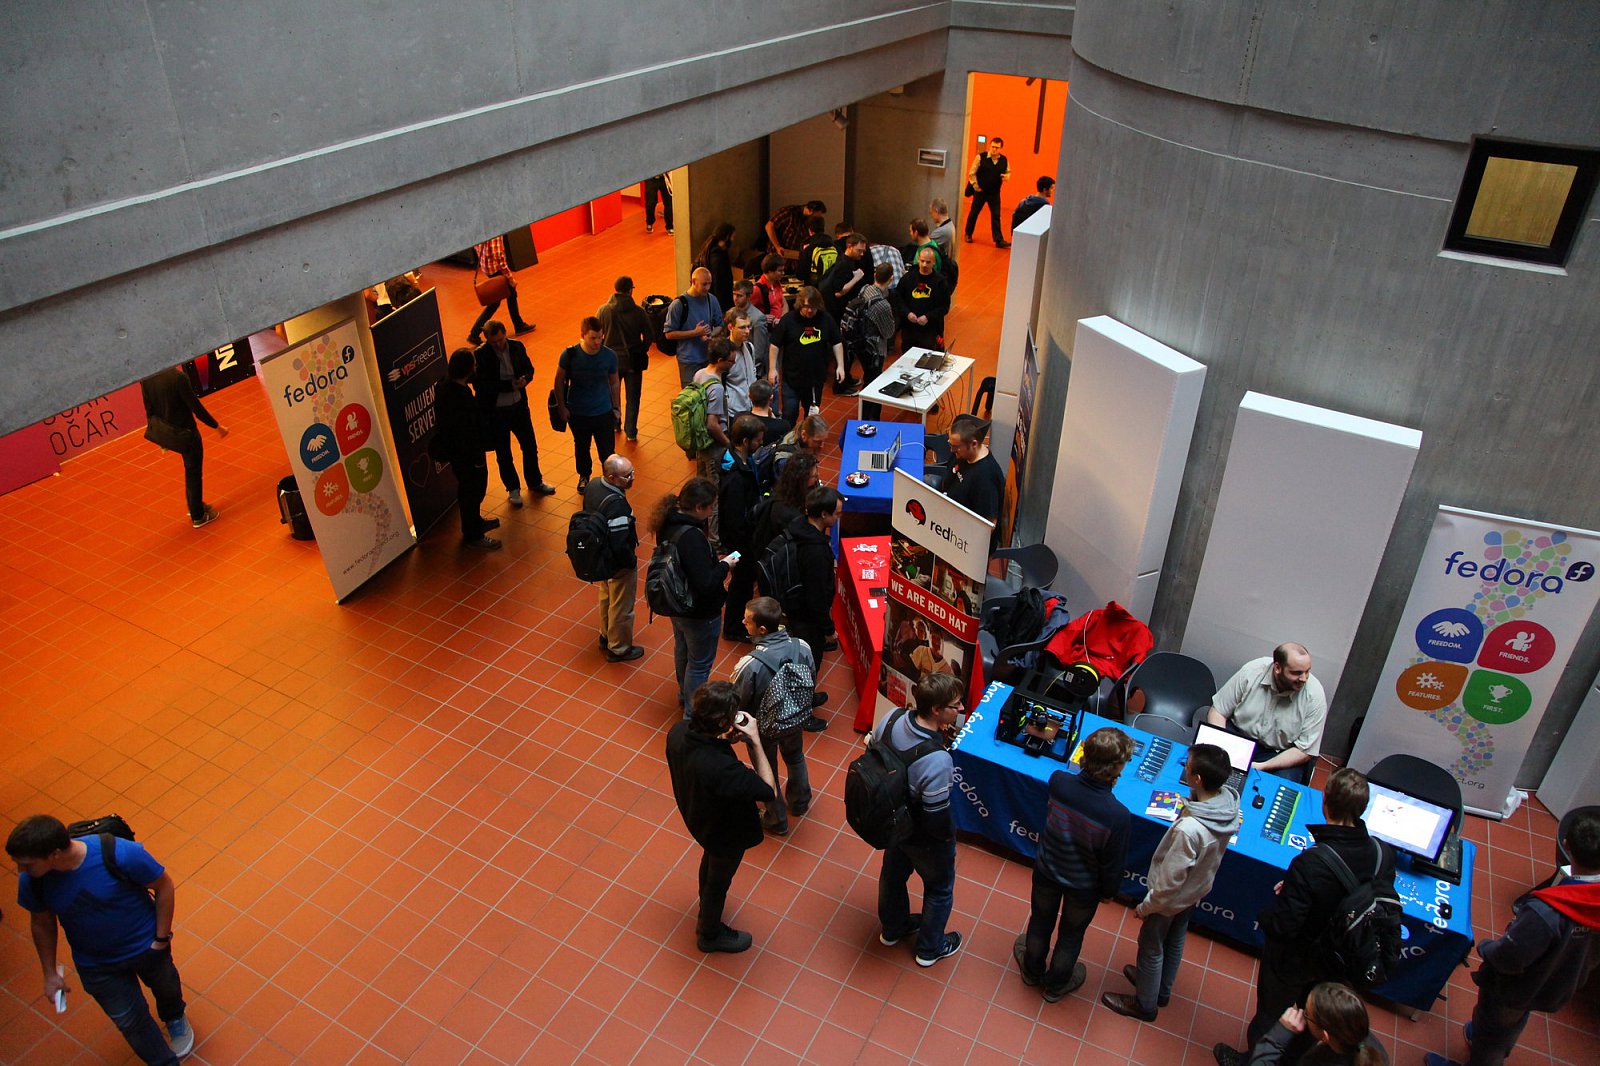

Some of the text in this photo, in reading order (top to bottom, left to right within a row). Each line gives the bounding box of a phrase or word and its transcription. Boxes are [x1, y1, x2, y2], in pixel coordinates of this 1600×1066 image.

[284, 365, 348, 407] fedora
[404, 381, 438, 421] MILUJEM
[49, 410, 118, 456] OČÁR
[1445, 551, 1563, 594] fedora
[891, 578, 968, 633] WE ARE RED HAT
[1427, 639, 1463, 650] FREEDOM.
[1498, 651, 1530, 664] FRIENDS.
[1009, 820, 1040, 843] fed
[1196, 901, 1235, 921] ora
